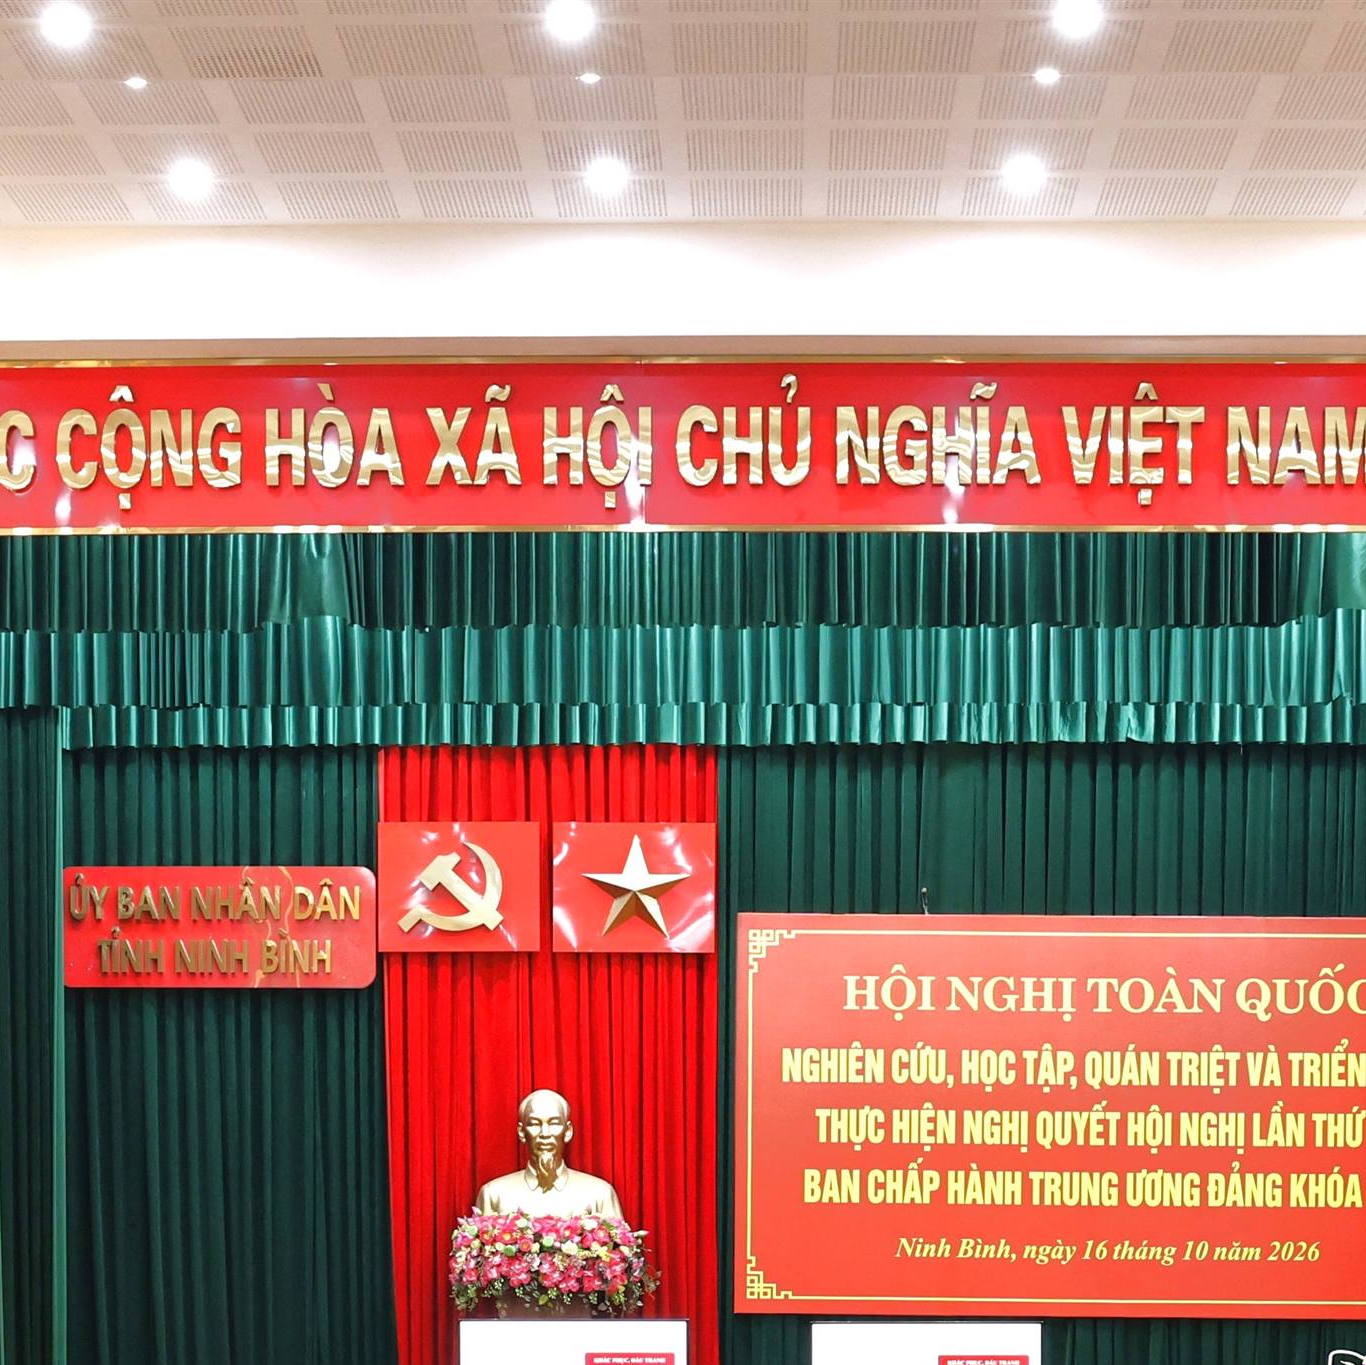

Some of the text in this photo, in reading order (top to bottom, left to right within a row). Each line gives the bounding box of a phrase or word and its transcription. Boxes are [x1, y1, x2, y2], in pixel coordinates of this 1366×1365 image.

[55, 385, 241, 510] CỘNG
[264, 383, 405, 488] HÒA
[425, 383, 522, 487] XÃ
[543, 384, 652, 508] HỘI
[675, 373, 811, 487] CHỦ
[836, 382, 1041, 486] NGHĨA
[1062, 382, 1207, 506] VIỆT
[69, 873, 361, 922] ỦY BAN NHÂN DÂN
[98, 927, 332, 975] TỈNH NINH BÌNH
[843, 964, 935, 1020] HỘI
[946, 977, 1076, 1021] NGHỊ
[1087, 967, 1225, 1013] TOÀN
[782, 1042, 884, 1083] NGHIÊN
[892, 1043, 954, 1088] CỨU,
[962, 1050, 1016, 1092] HỌC
[1023, 1043, 1077, 1093] TẬP,
[1085, 1044, 1159, 1089] QUÁN
[1166, 1045, 1240, 1094] TRIỆT
[1247, 1045, 1281, 1086] VÀ
[1288, 1039, 1366, 1087] TRIỂN
[815, 1105, 884, 1151] THỰC
[893, 1102, 955, 1151] HIỆN
[964, 1110, 1028, 1152] NGHỊ
[1036, 1101, 1120, 1149] QUYẾT
[1127, 1105, 1172, 1154] HỘI
[1180, 1112, 1245, 1154] NGHỊ
[1253, 1101, 1305, 1147] LẦN
[1312, 1106, 1366, 1147] THỨ
[804, 1169, 860, 1203] BAN
[868, 1158, 940, 1204] CHẤP
[948, 1166, 1022, 1205] HÀNH
[1029, 1172, 1118, 1206] TRUNG
[1126, 1169, 1200, 1207] ƯƠNG
[1207, 1161, 1282, 1207] ĐẢNG
[1290, 1167, 1362, 1208] KHÓA
[896, 1238, 1319, 1265] Ninh Bình, ngày 16 tháng 10 năm 2026
